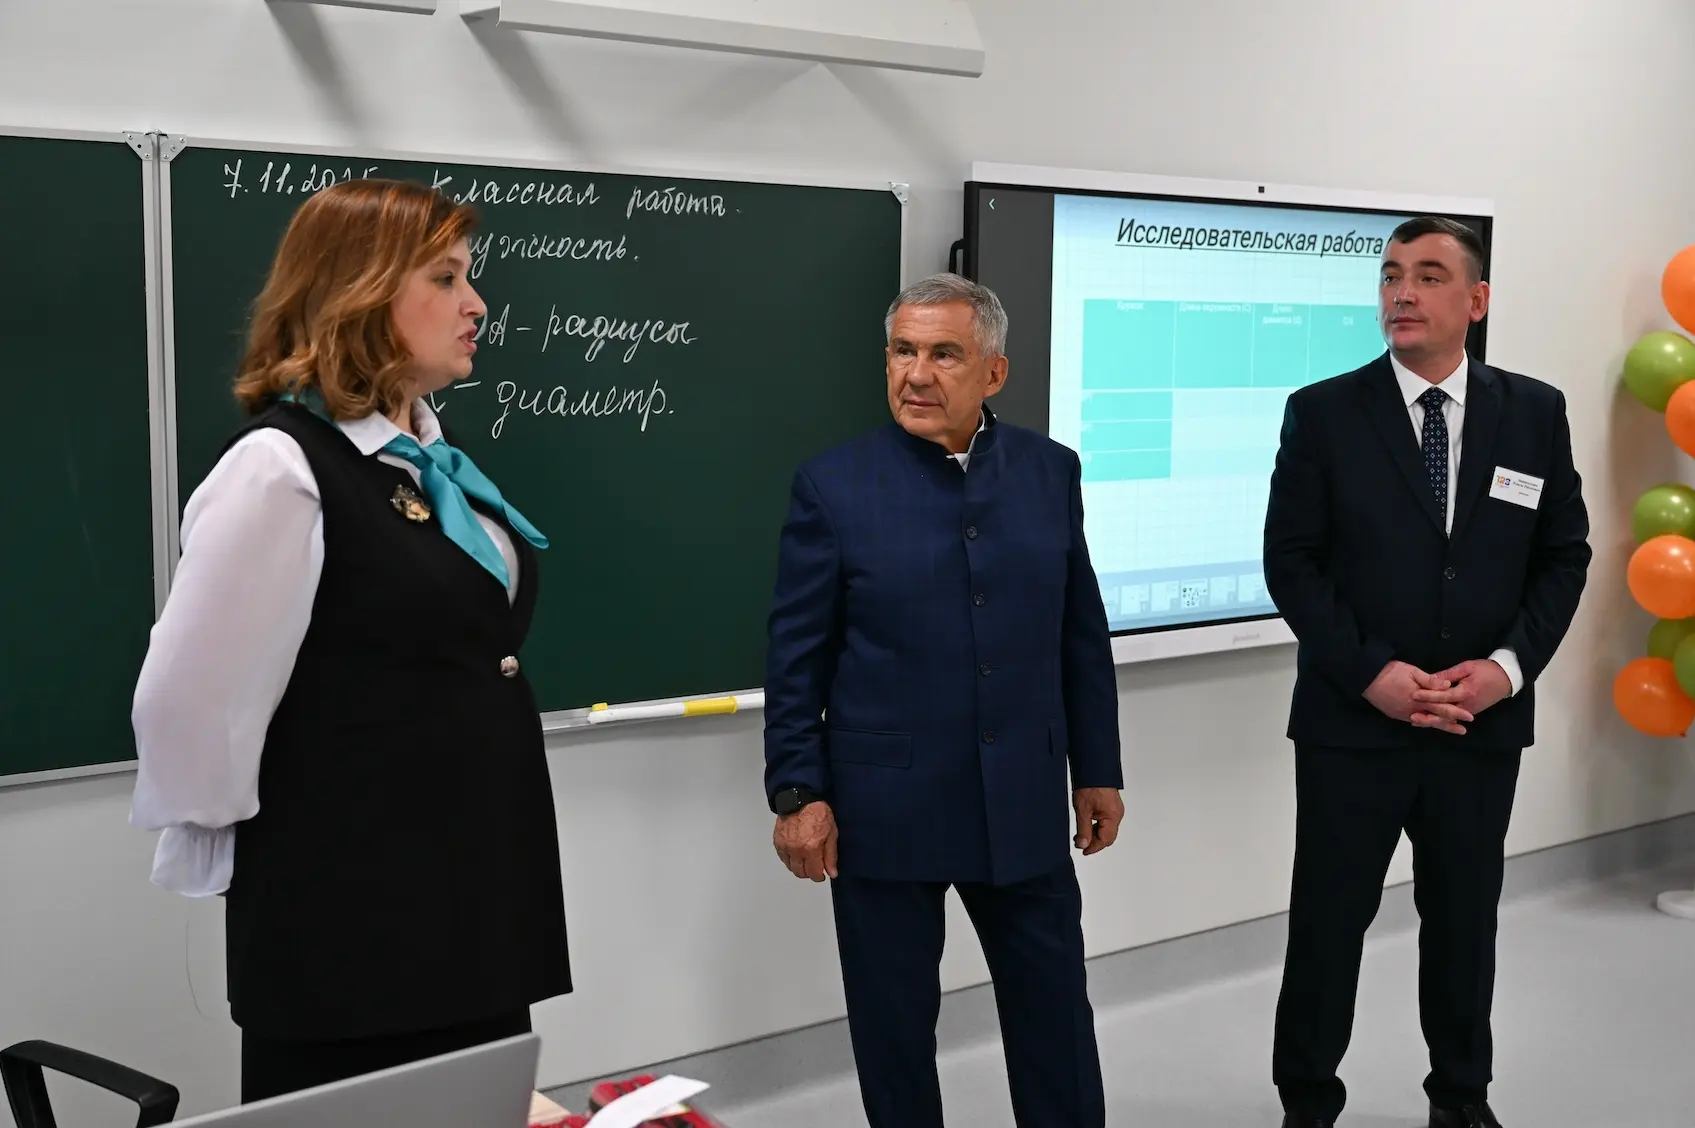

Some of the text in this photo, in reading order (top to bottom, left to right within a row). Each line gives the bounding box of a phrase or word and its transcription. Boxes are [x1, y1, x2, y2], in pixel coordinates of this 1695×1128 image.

[1116, 218, 1383, 257] Исследовательская работа
[491, 379, 675, 440] диаметр.
